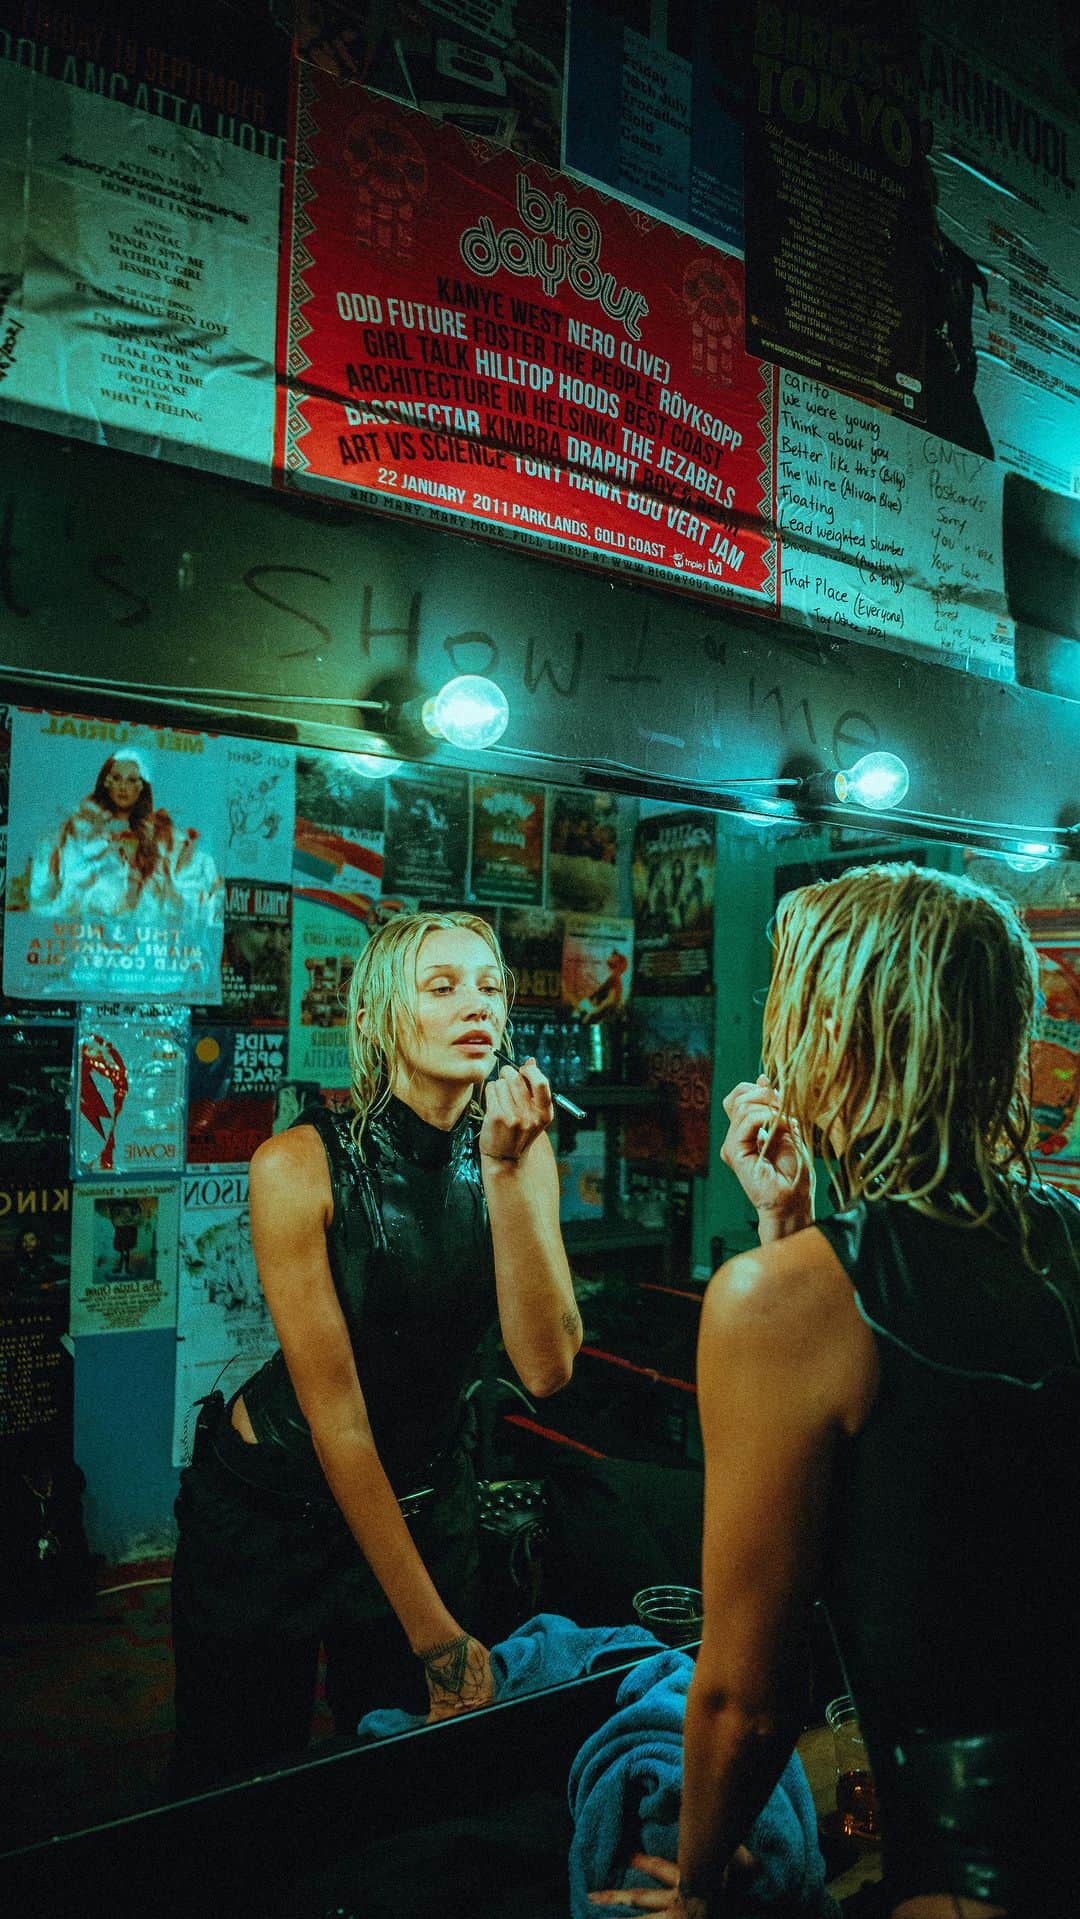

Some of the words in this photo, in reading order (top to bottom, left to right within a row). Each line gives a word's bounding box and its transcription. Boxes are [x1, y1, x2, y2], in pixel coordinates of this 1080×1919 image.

[100, 178, 132, 196] HOW
[136, 191, 164, 208] WILL
[176, 203, 214, 224] KNOW
[516, 172, 601, 263] big
[107, 230, 148, 251] VENUS
[158, 246, 185, 262] SPIN
[186, 255, 205, 270] ME
[132, 225, 182, 249] MANIAC
[108, 243, 170, 271] MATERIAL
[174, 263, 203, 281] GIRL
[164, 273, 194, 291] GIRL
[166, 307, 197, 326] BEEN
[200, 318, 231, 336] LOVE
[437, 275, 504, 319] KANYE
[510, 296, 562, 338] WEST
[567, 318, 616, 360] NERO
[619, 341, 671, 384] (LIVE)
[100, 351, 135, 370] TURN
[139, 361, 173, 380] BACK
[178, 371, 204, 388] TIME
[115, 341, 148, 360] TAKE
[151, 351, 171, 366] ON
[175, 359, 193, 372] ME
[336, 292, 383, 324] ODD
[386, 297, 468, 340] FUTURE
[472, 316, 546, 362] FOSTER
[550, 339, 587, 379] THE
[591, 355, 655, 406] PEOPLE
[658, 387, 743, 452] RÖYKSOPP
[100, 386, 139, 406] WHAT
[143, 397, 152, 410] A
[154, 399, 203, 423] FEELING
[117, 368, 188, 397] FOOTLOOSE
[362, 328, 413, 361] GIRL
[415, 334, 470, 371] TALK
[475, 347, 554, 394] HILLTOP
[558, 372, 621, 420] HOODS
[624, 398, 669, 441] BEST
[670, 422, 724, 470] COAST
[784, 373, 830, 399] carito
[345, 363, 502, 411] ARCHITECTURE
[508, 388, 527, 417] IN
[533, 392, 617, 447] HELSINKI
[620, 426, 656, 465] THE
[657, 445, 738, 511] JEZABELS
[780, 410, 823, 439] Think
[827, 430, 865, 453] about
[870, 446, 889, 465] you
[782, 391, 801, 408] We
[806, 401, 837, 421] were
[844, 413, 881, 442] young
[343, 399, 481, 438] BASSNECTAR
[486, 413, 561, 461] KIMBRA
[566, 435, 640, 482] DRAPHT
[779, 435, 823, 462] Better
[829, 451, 850, 474] like
[854, 459, 876, 479] this
[779, 461, 802, 481] The
[805, 469, 838, 492] Wire
[337, 431, 381, 466] ART
[384, 430, 418, 461] VS
[419, 429, 509, 470] SCIENCE
[512, 455, 563, 486] TONY
[666, 506, 711, 547] VERT
[708, 533, 746, 572] JAM
[376, 467, 398, 487] 22
[400, 473, 467, 506] JANUARY
[471, 493, 509, 518] 2011
[511, 502, 592, 541] PARKLANDS,
[593, 526, 626, 548] GOLD
[627, 535, 667, 560] COAST
[780, 484, 836, 525] Floating
[349, 488, 378, 505] AND
[430, 508, 466, 528] MANY
[512, 531, 543, 548] FULL
[547, 540, 590, 561] LINEUP
[592, 549, 608, 563] AT
[779, 509, 813, 535] Lead
[816, 524, 867, 552] weighted
[781, 567, 812, 589] That
[814, 577, 849, 603] Place
[853, 592, 905, 629] (Everyone)
